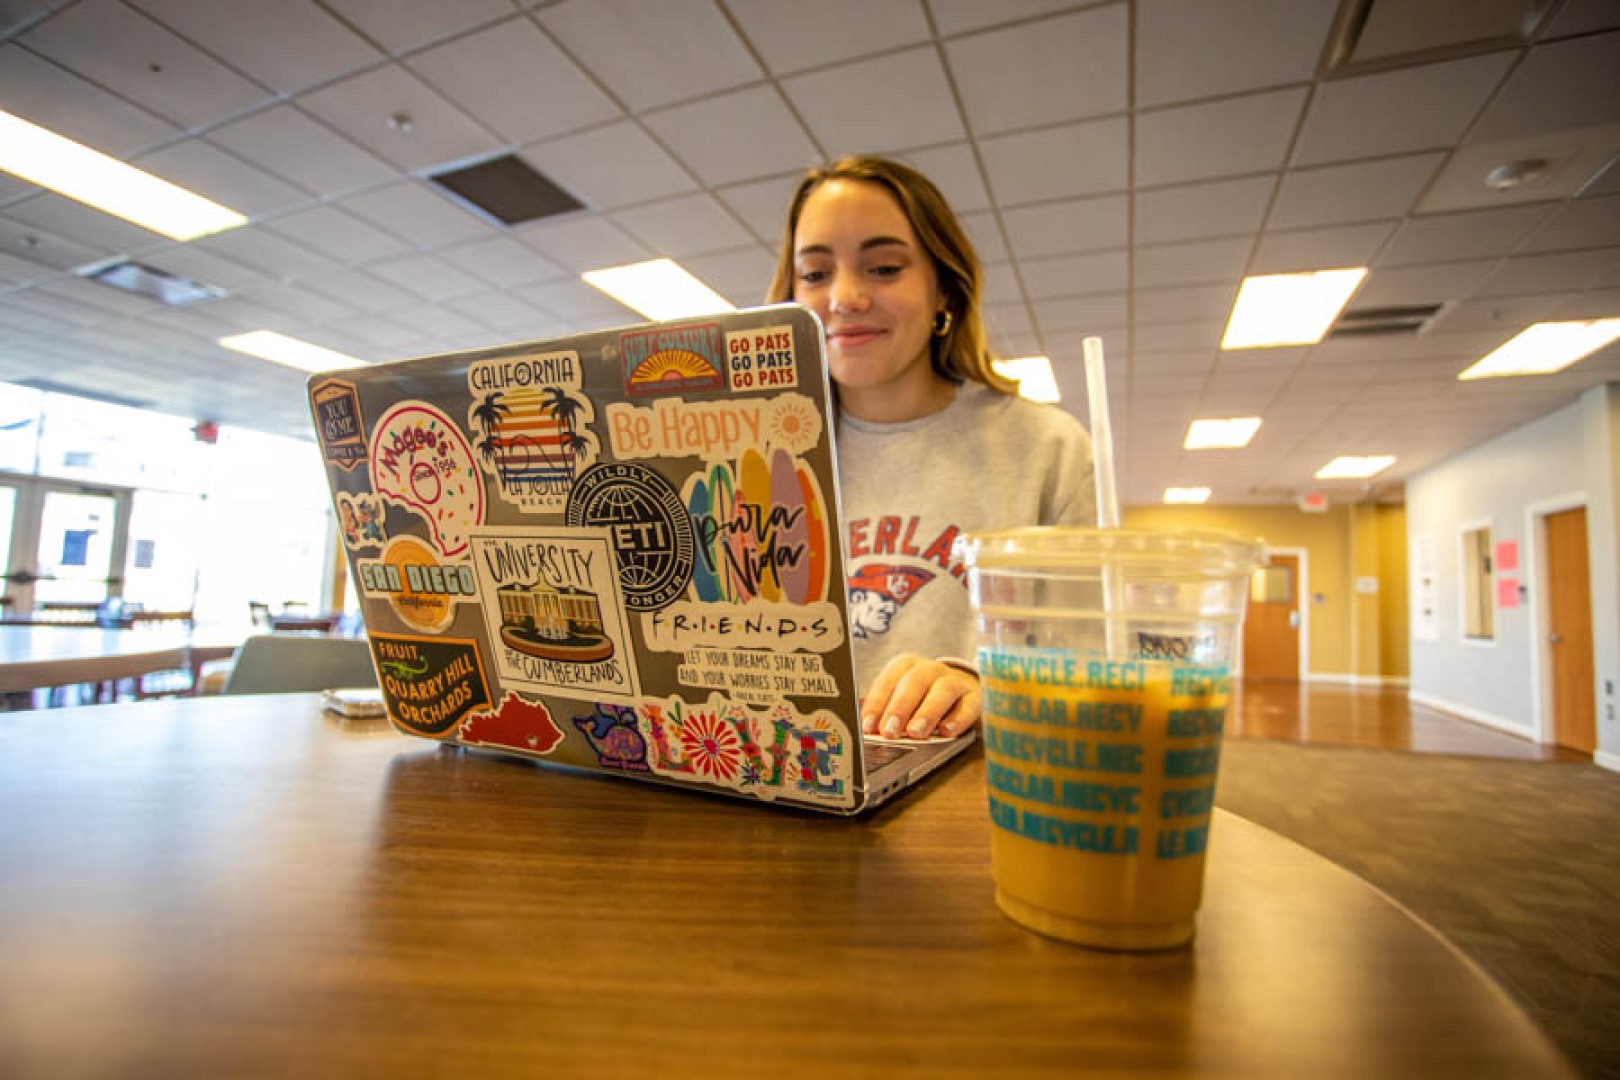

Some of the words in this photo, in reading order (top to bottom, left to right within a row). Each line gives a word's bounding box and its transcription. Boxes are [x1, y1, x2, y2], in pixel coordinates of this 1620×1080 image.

[729, 337, 750, 354] GO
[755, 332, 791, 351] PATS
[471, 357, 574, 390] CALIFORNIA
[731, 353, 752, 371] GO
[756, 350, 793, 368] PATS
[733, 371, 753, 388] GO
[758, 367, 795, 386] PATS
[612, 411, 654, 453] Be
[659, 406, 761, 454] Happy
[584, 464, 651, 488] WILDLY
[521, 497, 563, 505] BEACH
[614, 522, 667, 550] ETI
[483, 541, 593, 588] UNIVERSITY
[361, 563, 403, 592] SAN
[404, 565, 477, 596] DIEGO
[630, 574, 684, 605] ONGER
[378, 642, 418, 661] FRUIT
[705, 651, 730, 667] YOUR
[731, 652, 771, 670] DREAMS
[773, 654, 796, 672] STAY
[802, 656, 820, 672] BIG
[384, 672, 443, 700] QUARRY
[444, 652, 475, 686] HILL
[522, 657, 625, 685] CUMBERLANDS
[702, 670, 725, 685] YOUR
[730, 673, 770, 691] WORRIES
[773, 675, 796, 692] STAY
[801, 677, 837, 694] SMALL
[398, 680, 472, 724] ORCHARDS
